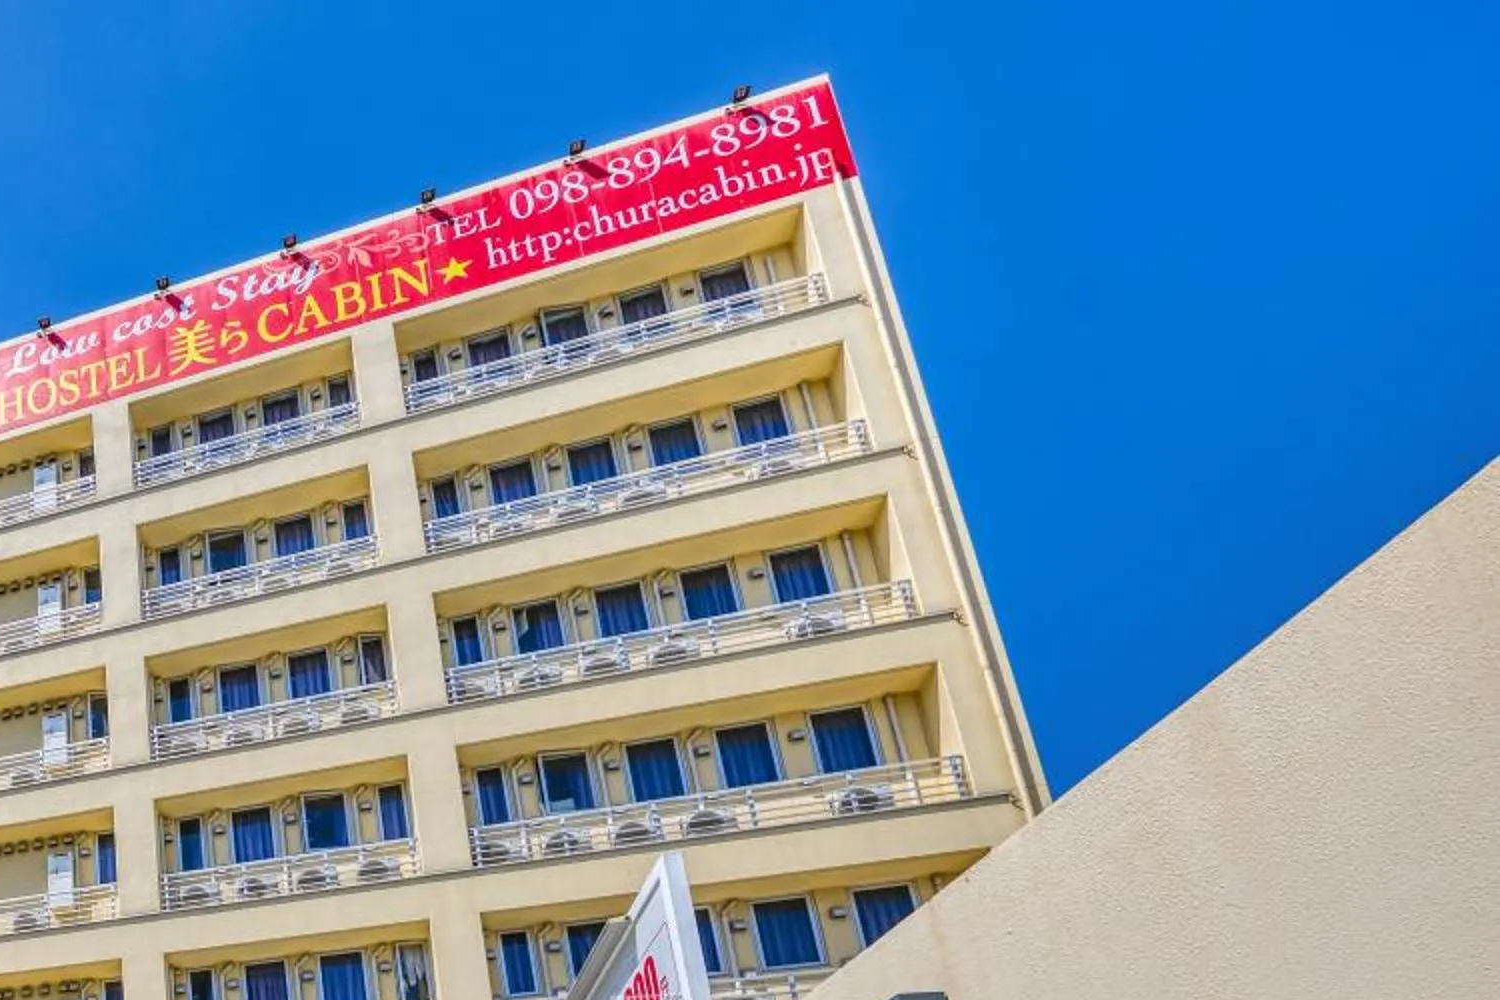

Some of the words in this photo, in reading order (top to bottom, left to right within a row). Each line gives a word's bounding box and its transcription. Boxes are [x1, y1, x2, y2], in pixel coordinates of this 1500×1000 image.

[427, 207, 502, 245] TEL
[509, 94, 829, 220] 098-894-8981
[4, 331, 101, 377] Low
[113, 291, 197, 344] cost
[211, 259, 325, 312] Stay
